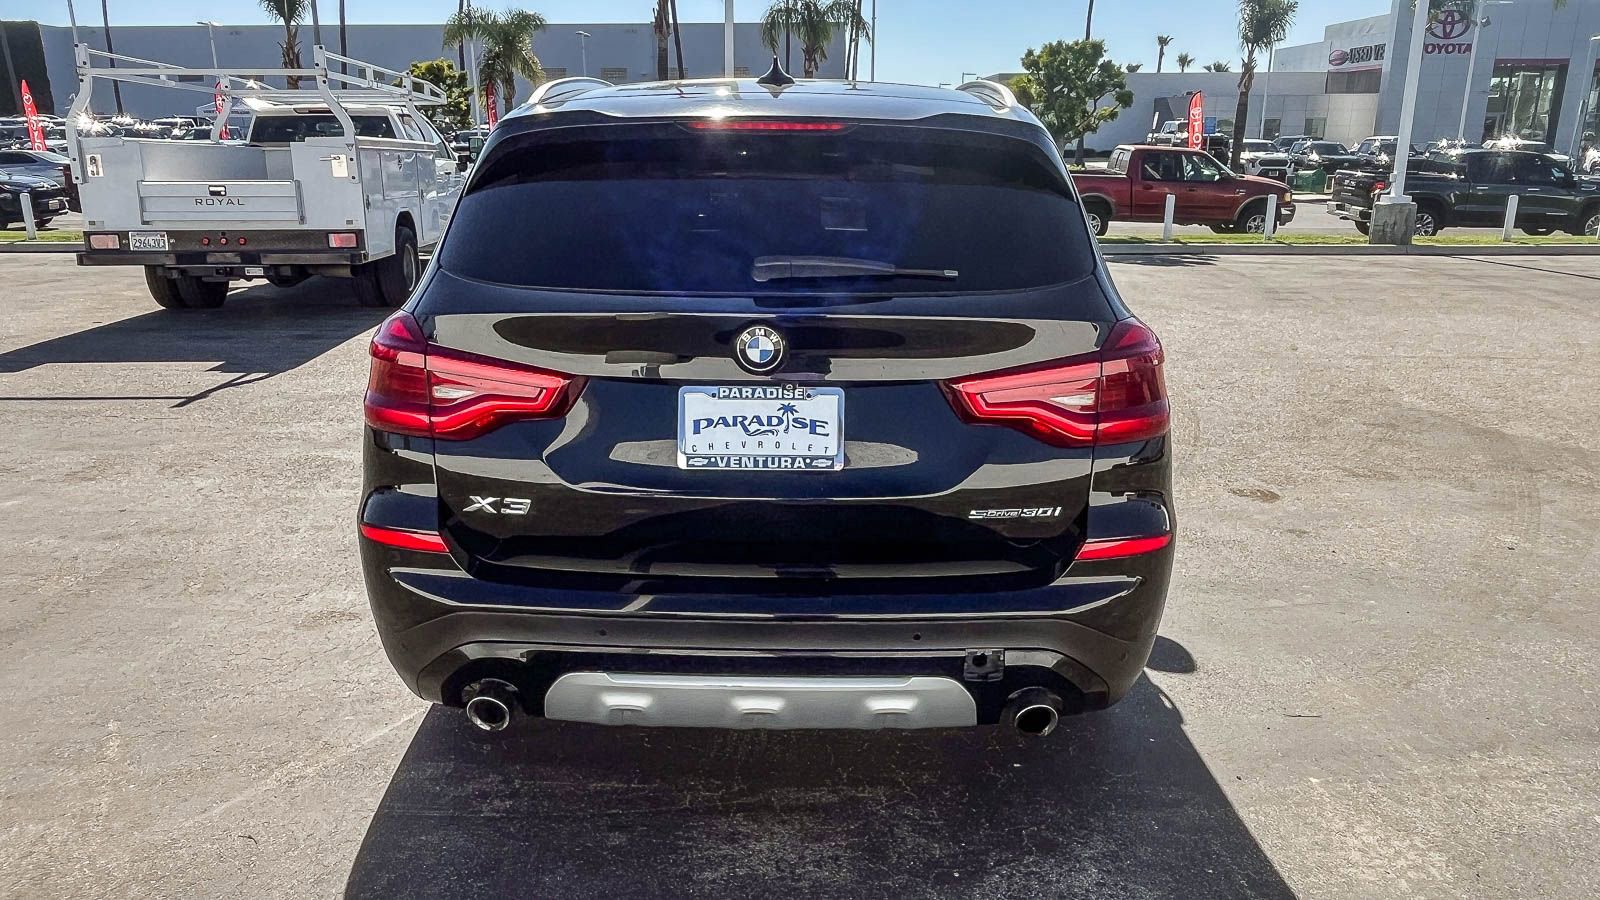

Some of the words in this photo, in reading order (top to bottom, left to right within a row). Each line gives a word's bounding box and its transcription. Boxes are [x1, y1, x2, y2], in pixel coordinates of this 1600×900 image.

[1349, 46, 1373, 64] USED
[1424, 43, 1472, 55] OYOTA
[195, 198, 246, 206] ROYAL
[742, 328, 779, 343] BMW
[719, 387, 805, 399] PARADISE
[692, 403, 830, 437] PARADISE
[691, 440, 829, 454] CHEVROLET
[716, 457, 806, 469] VENTURA
[462, 495, 532, 515] X3
